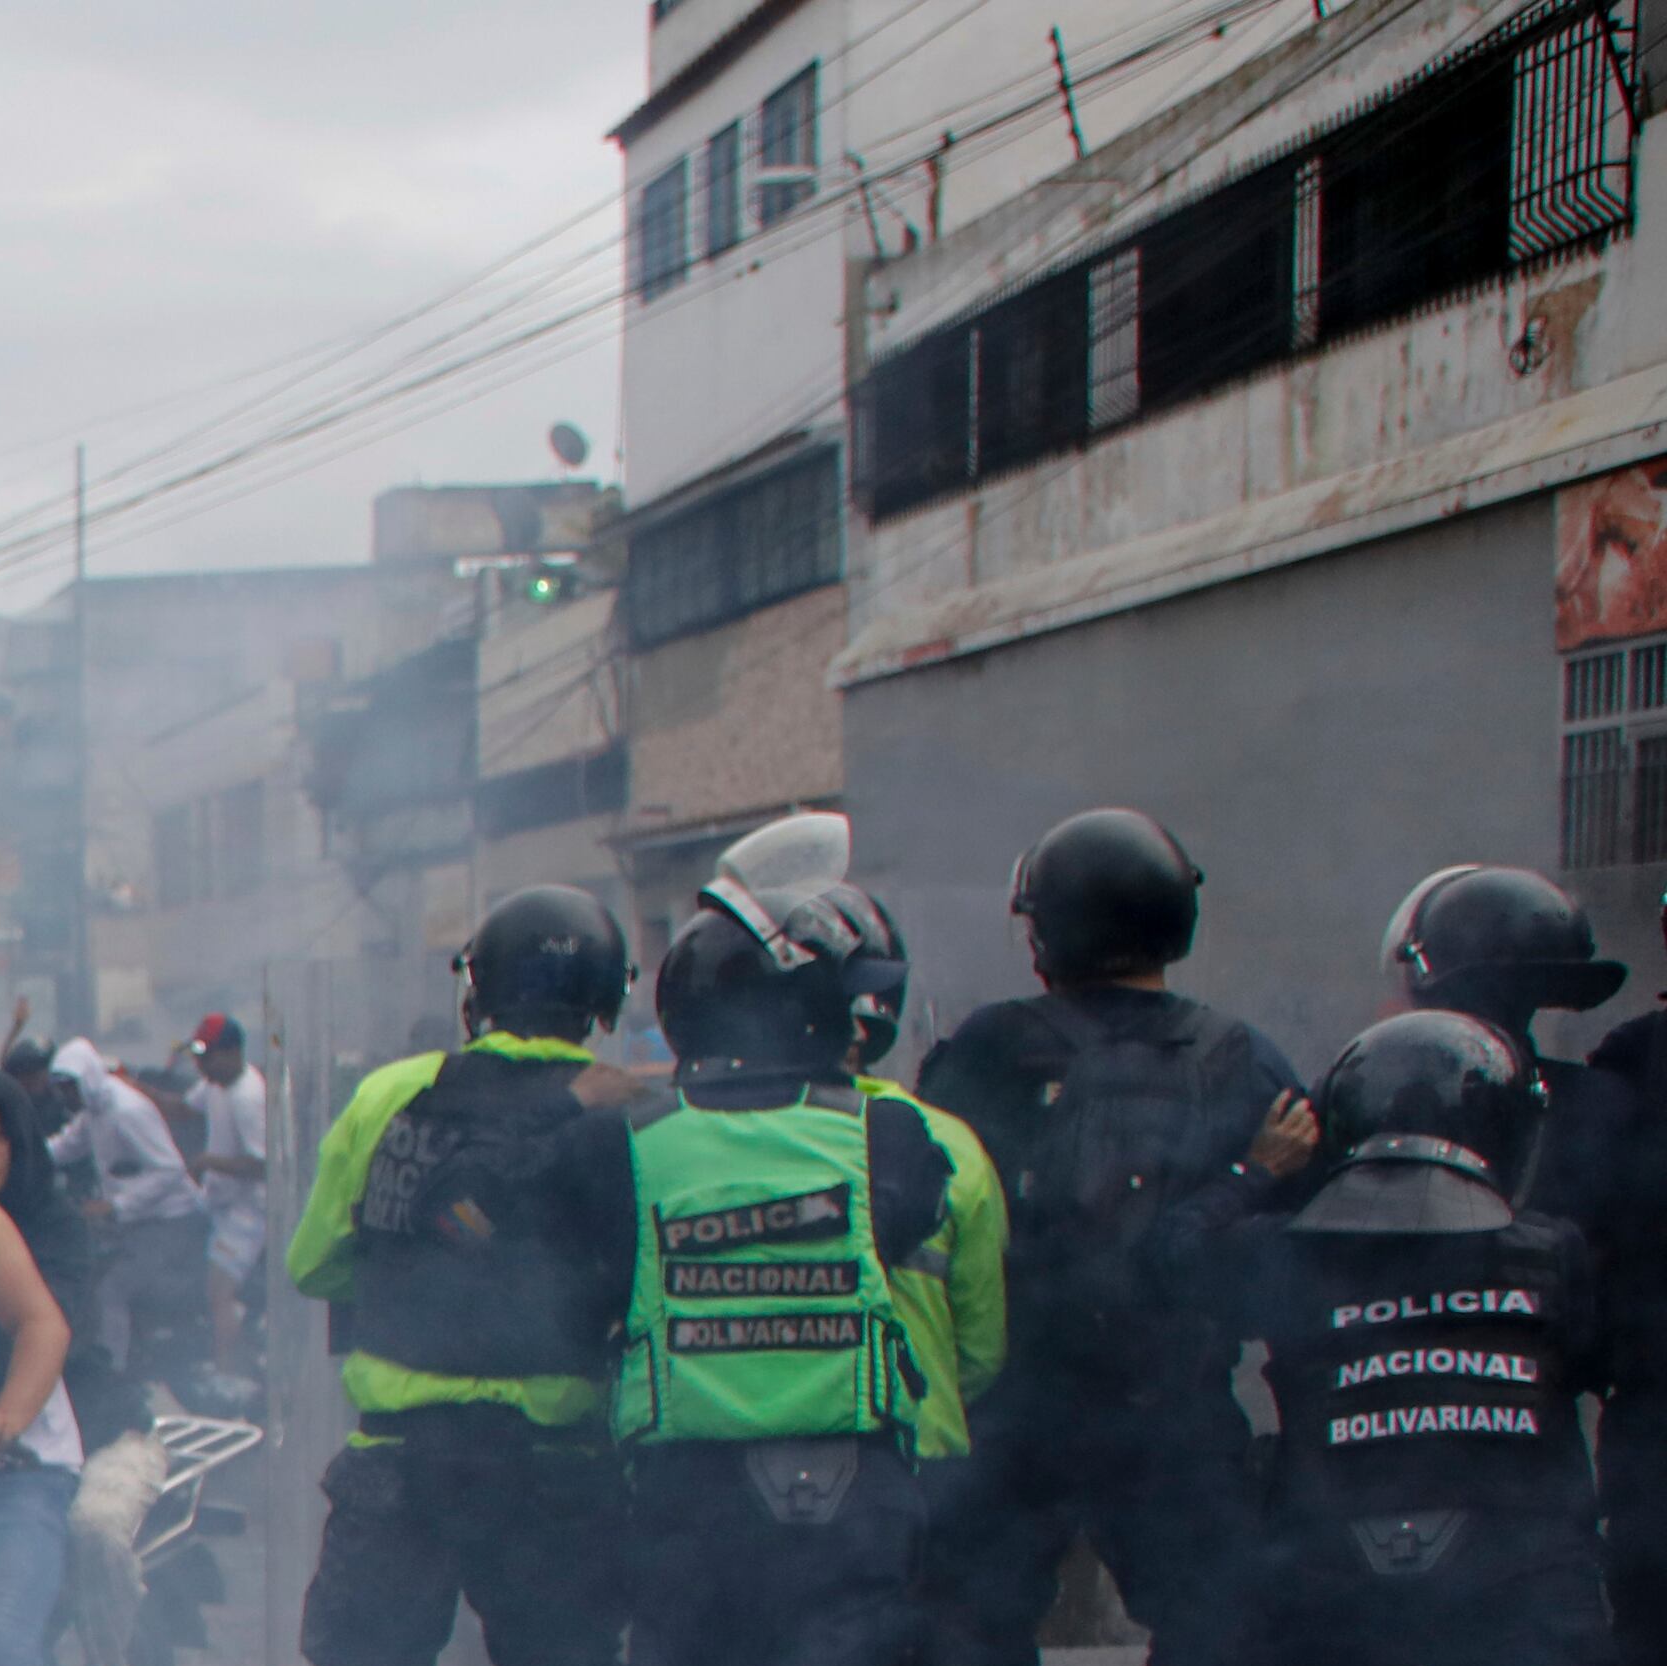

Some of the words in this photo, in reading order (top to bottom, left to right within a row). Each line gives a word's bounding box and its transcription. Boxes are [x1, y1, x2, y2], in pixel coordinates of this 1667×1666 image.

[674, 1266, 850, 1293] NACIONAL
[1332, 1289, 1534, 1329] POLICIA
[1337, 1348, 1537, 1388] NACIONAL
[1328, 1405, 1539, 1444] BOLIVARIANA
